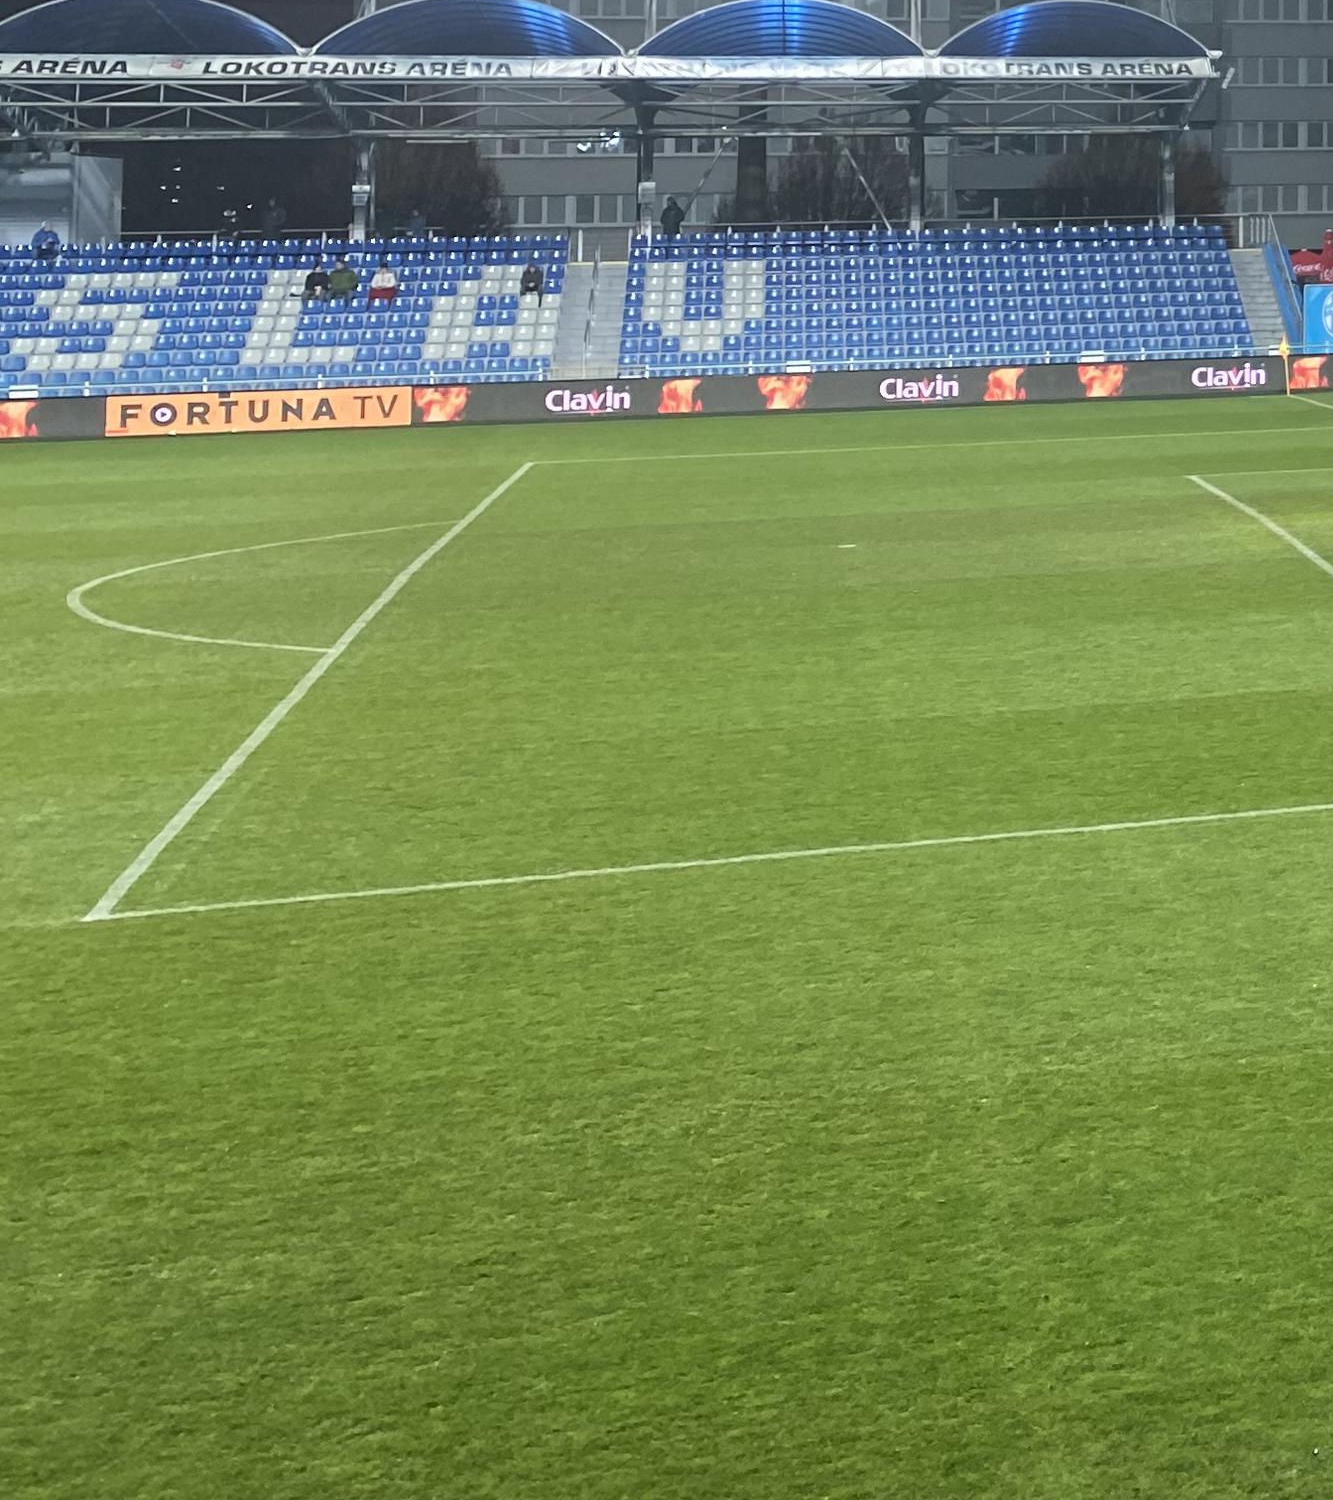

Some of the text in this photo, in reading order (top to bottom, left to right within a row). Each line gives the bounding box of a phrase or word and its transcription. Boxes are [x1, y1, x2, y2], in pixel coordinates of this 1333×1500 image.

[201, 60, 397, 76] LOKOTRANS
[930, 60, 1094, 77] OKOTRANS
[879, 373, 960, 402] Clavin
[1191, 362, 1266, 388] Clavin
[119, 394, 400, 429] FORTUNA TV
[545, 385, 631, 414] Clavin
